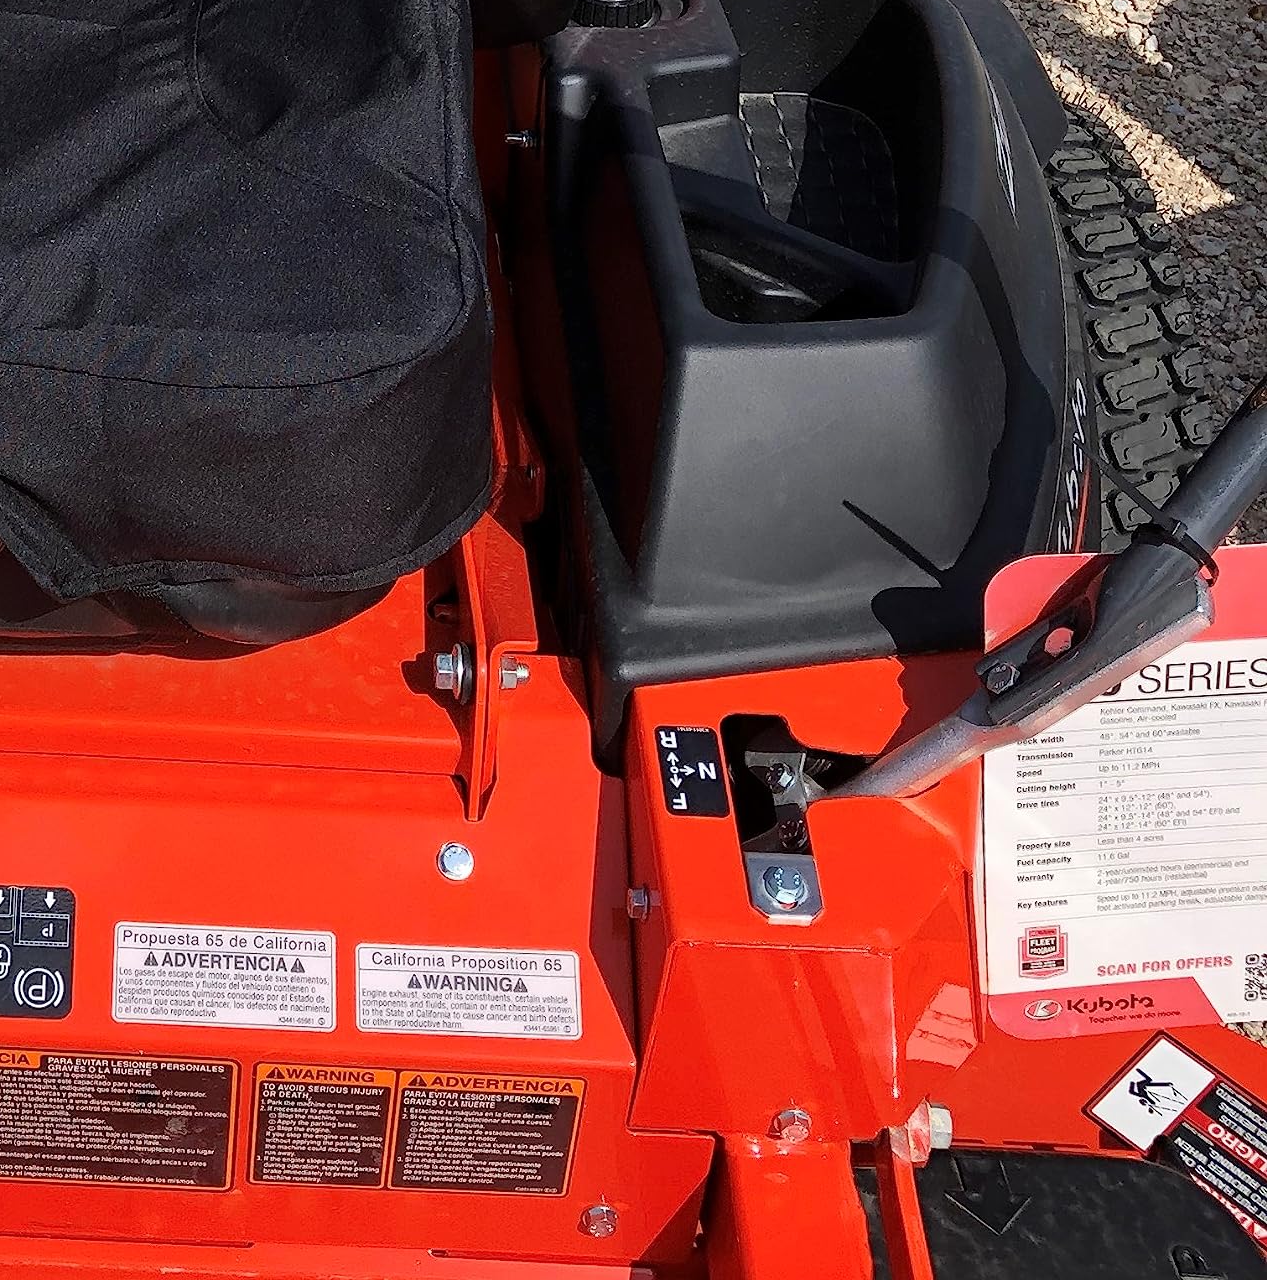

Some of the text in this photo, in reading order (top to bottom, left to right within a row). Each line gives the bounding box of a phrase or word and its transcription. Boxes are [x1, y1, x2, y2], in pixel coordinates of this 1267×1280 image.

[1137, 658, 1267, 694] SERIES
[659, 731, 678, 748] R
[1041, 736, 1065, 744] width
[1017, 751, 1073, 761] Transmission
[697, 762, 717, 780] N
[1016, 768, 1042, 778] Speed
[1016, 781, 1076, 794] Cutting height
[672, 793, 687, 810] F
[1017, 799, 1059, 809] Drive tires
[1017, 839, 1071, 852] Property size
[1017, 855, 1072, 866] Fuel capacity
[1017, 872, 1054, 882] Warranty
[1017, 897, 1068, 910] Key features
[122, 930, 326, 952] Propuesta 65 de California
[161, 952, 287, 972] ADVERTENCIA
[371, 951, 562, 972] California Proposition 65
[1097, 955, 1233, 977] SCAN FOR OFFERS
[423, 974, 514, 992] WARNING
[1067, 993, 1154, 1014] Kubota
[48, 1056, 225, 1073] PARA EVITAR LESIONES PERSONALES
[48, 1064, 86, 1073] GRAVES
[112, 1068, 152, 1077] MUERTE
[286, 1068, 375, 1083] WARNING
[307, 1085, 348, 1094] SERIOUS
[351, 1088, 384, 1096] INJURY
[431, 1076, 573, 1093] ADVERTENCIA
[403, 1098, 438, 1107] GRAVES
[448, 1100, 459, 1108] LA
[461, 1101, 496, 1109] MUERTE
[404, 1090, 561, 1105] PARA EVITAR LESIONES PERSONALES
[1207, 1121, 1267, 1174] LIGRO
